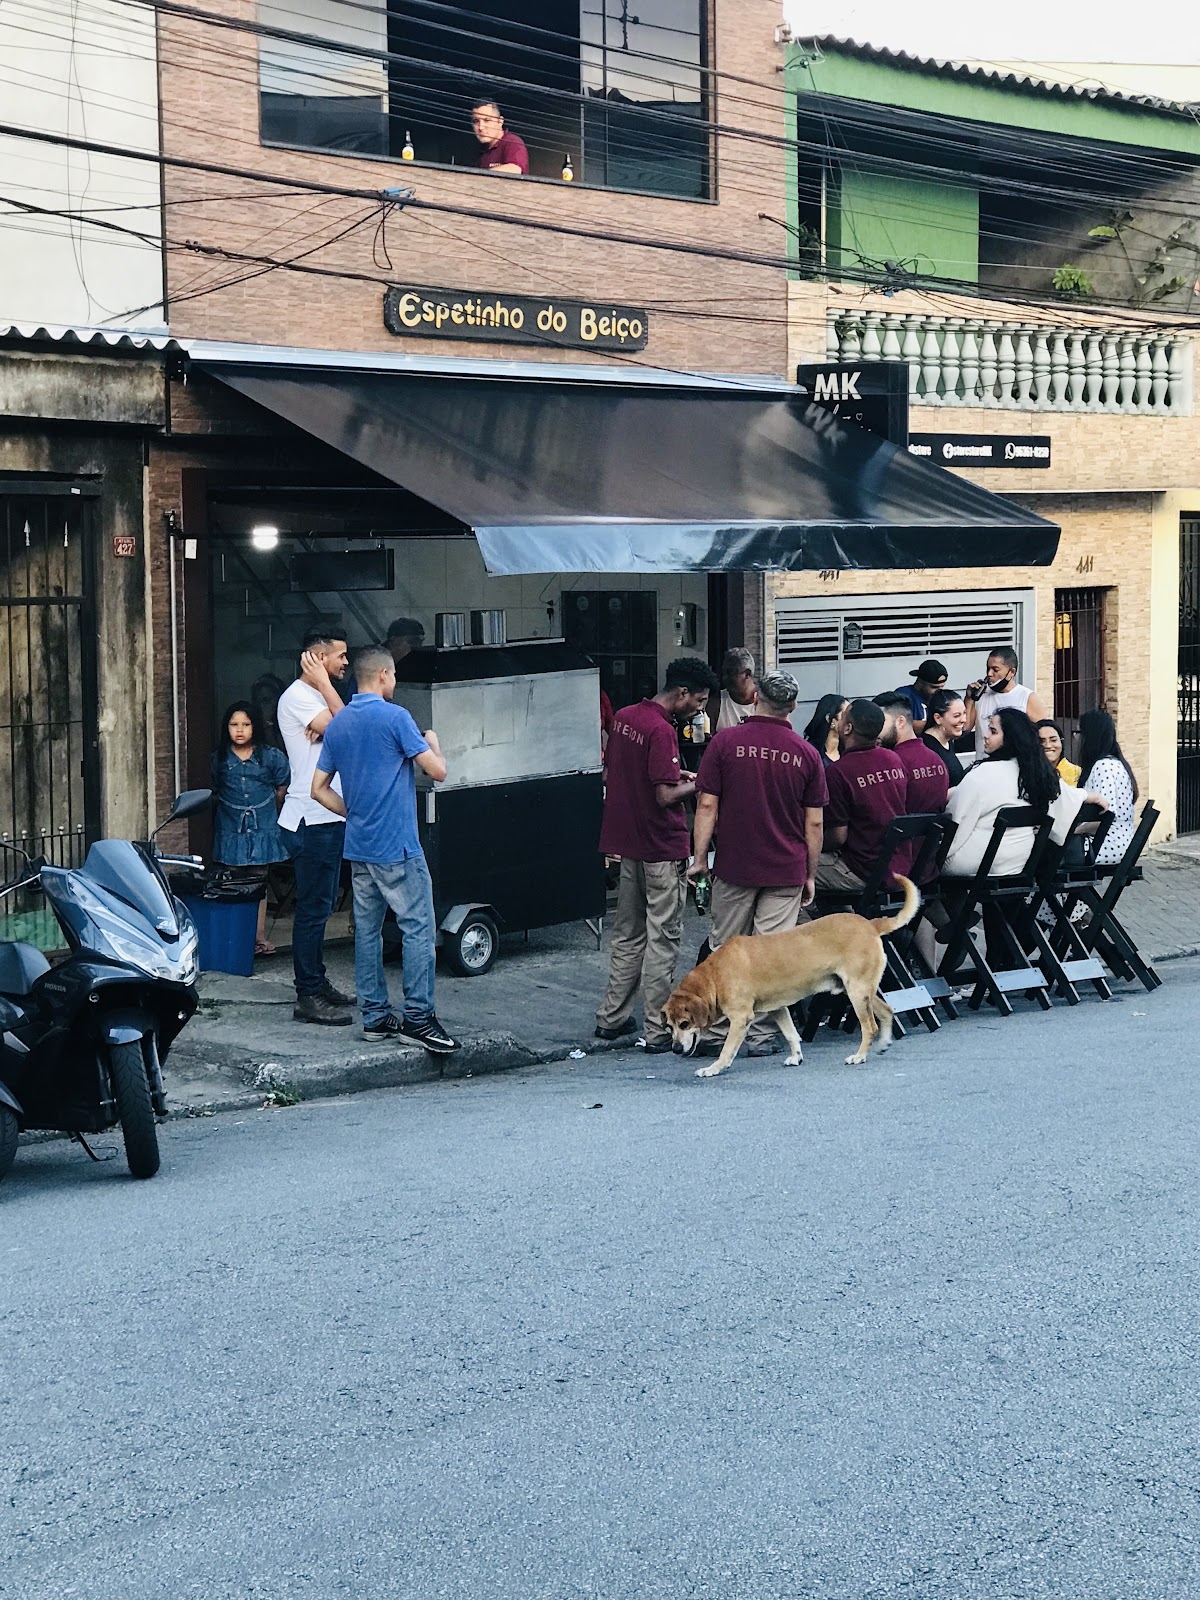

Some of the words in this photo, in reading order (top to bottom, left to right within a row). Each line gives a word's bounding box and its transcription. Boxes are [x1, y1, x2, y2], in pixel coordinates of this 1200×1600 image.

[400, 292, 524, 329] Espetinho
[537, 305, 567, 332] do
[580, 308, 642, 344] Beiço
[814, 372, 862, 401] MK
[117, 543, 133, 555] 427
[736, 745, 802, 768] BRETON
[857, 768, 905, 788] BRETON
[44, 982, 67, 993] HONDA
